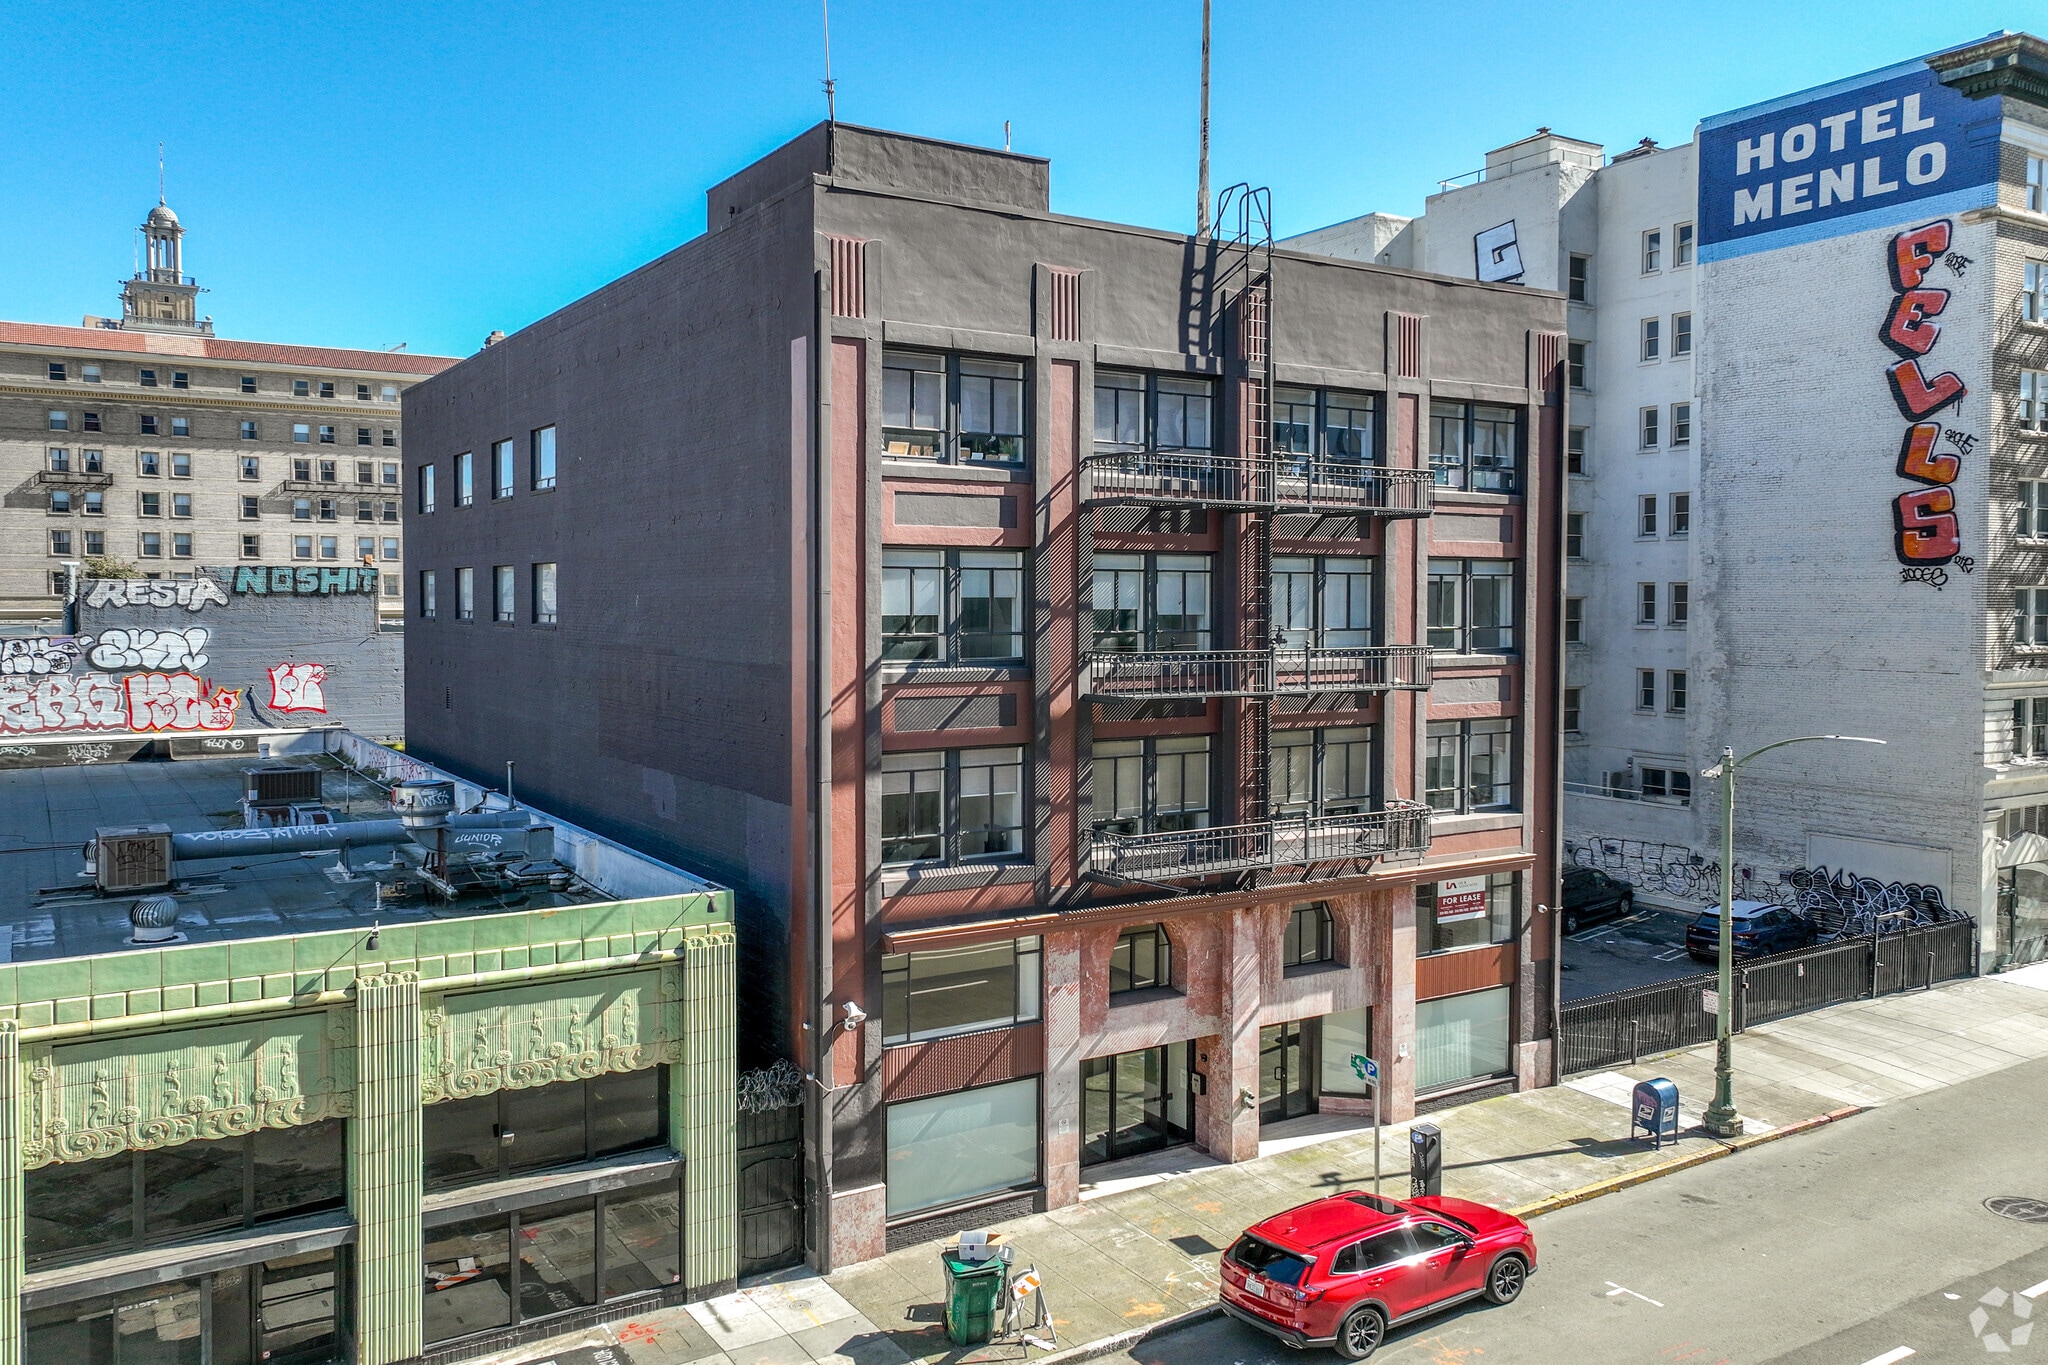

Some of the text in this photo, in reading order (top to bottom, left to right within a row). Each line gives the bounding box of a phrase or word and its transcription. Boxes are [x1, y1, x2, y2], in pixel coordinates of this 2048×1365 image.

[1736, 93, 1935, 176] HOTEL
[1734, 141, 1947, 226] MENLO
[1878, 219, 1967, 567] FELLS
[86, 578, 229, 611] RESTA
[1442, 896, 1458, 905] FOR
[1460, 893, 1481, 903] LEASE
